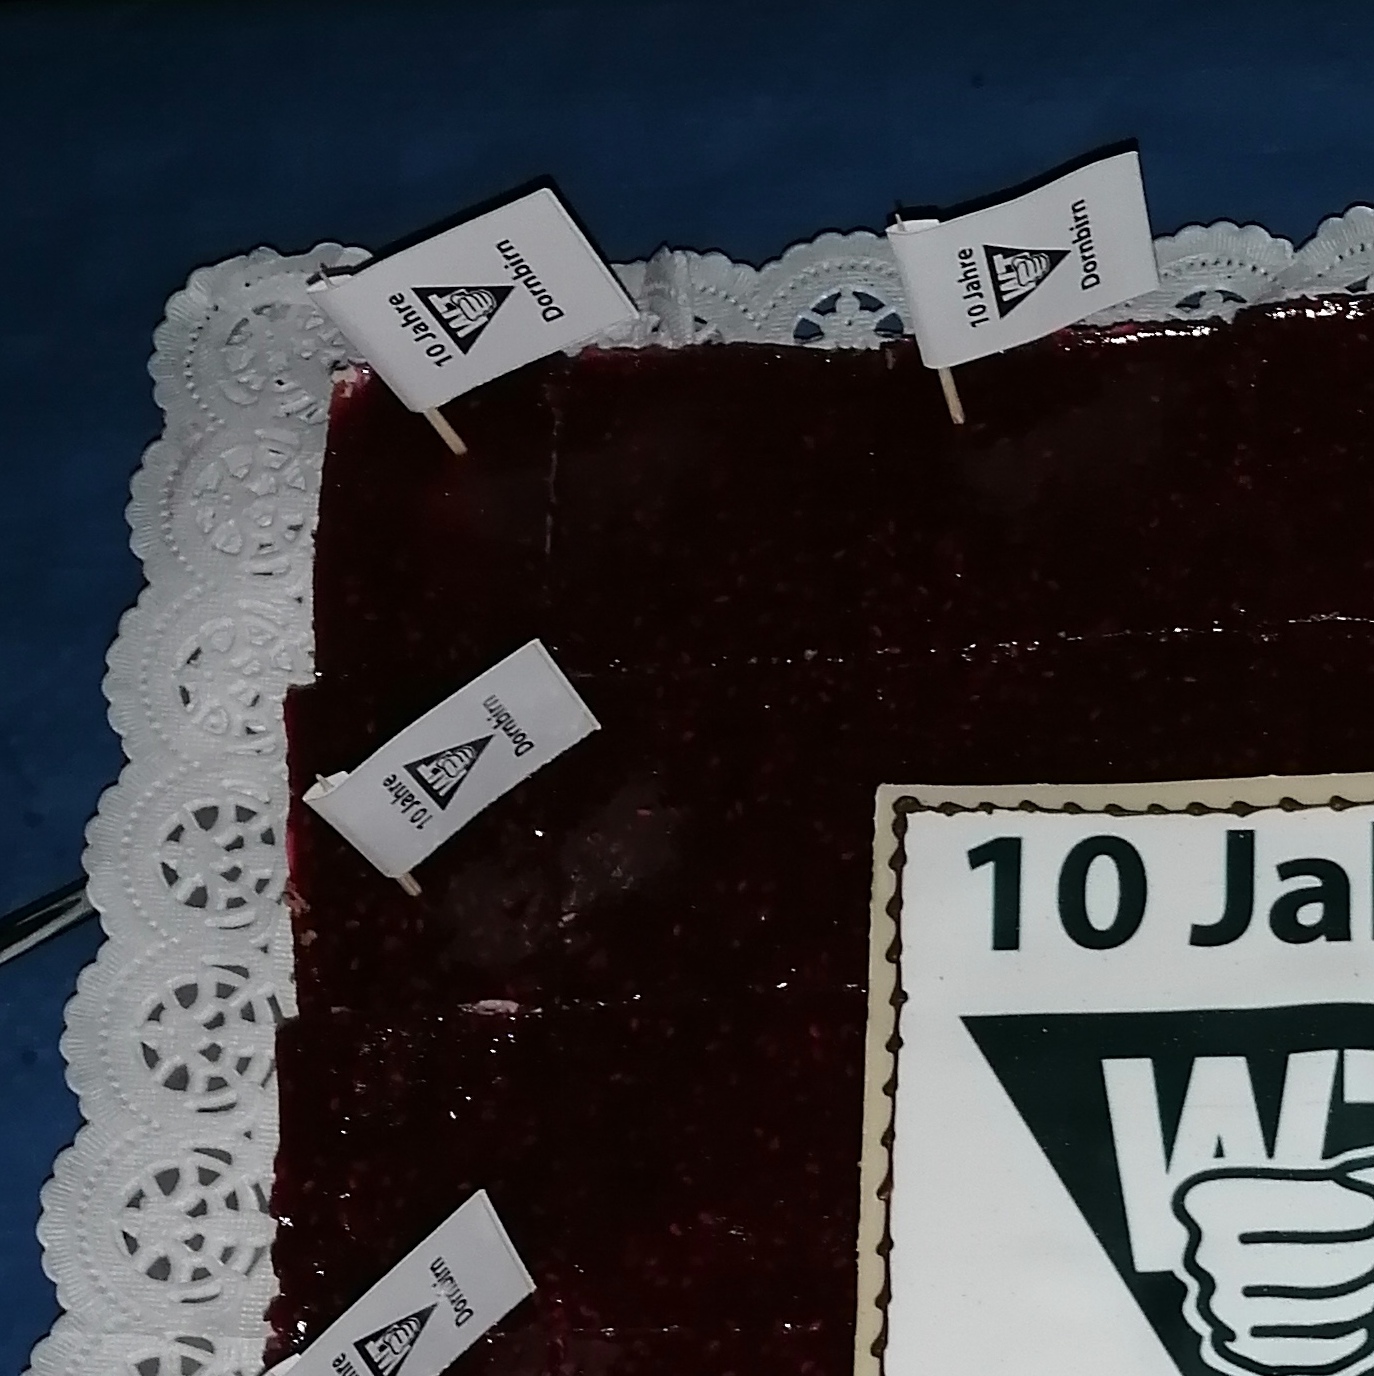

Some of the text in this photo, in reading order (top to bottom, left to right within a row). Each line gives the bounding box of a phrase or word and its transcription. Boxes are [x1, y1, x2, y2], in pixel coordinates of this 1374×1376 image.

[496, 239, 564, 323] Dornbirn
[1070, 199, 1100, 290] Dornbirn
[958, 248, 989, 328] 10 Jahre
[389, 293, 453, 367] 10 Jahre
[482, 694, 534, 757] Dornbirn
[382, 774, 433, 829] 10 Jahre
[965, 834, 1149, 952] 10
